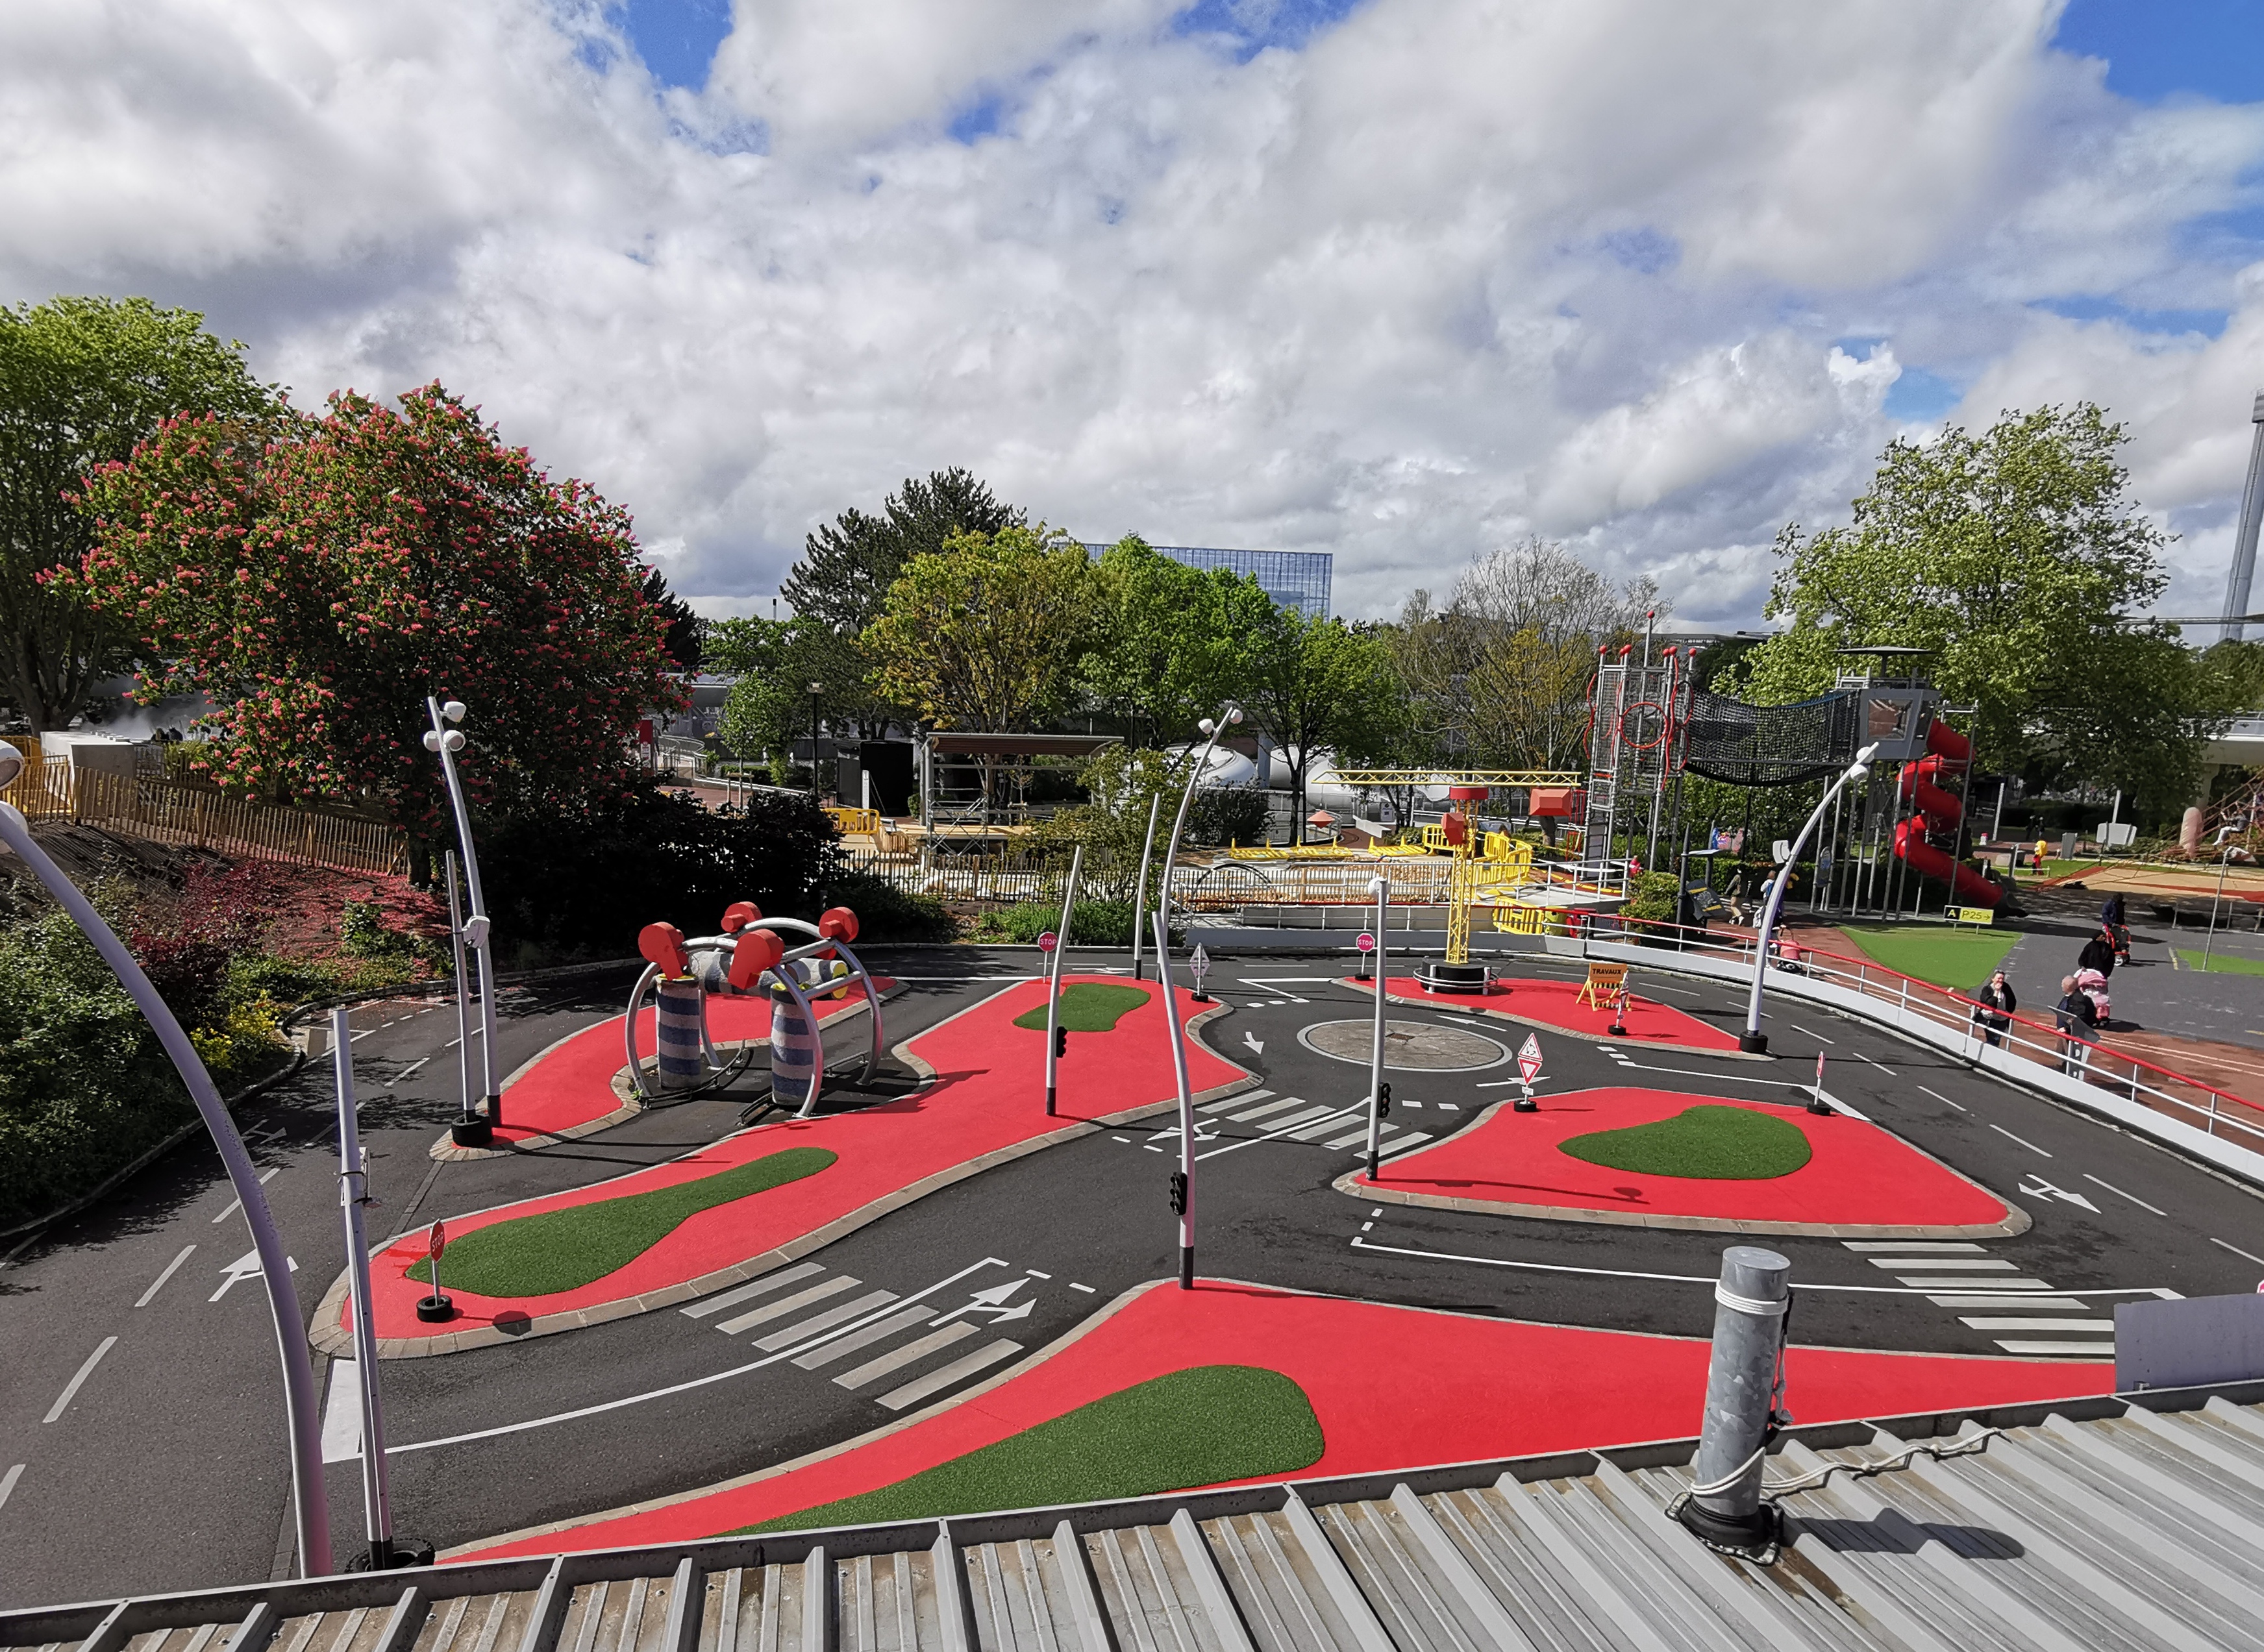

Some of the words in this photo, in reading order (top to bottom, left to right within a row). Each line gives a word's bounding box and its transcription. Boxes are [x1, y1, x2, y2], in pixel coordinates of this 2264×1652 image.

[1948, 909, 1956, 917] A
[1961, 910, 1982, 920] P25
[431, 1231, 443, 1252] STOP
